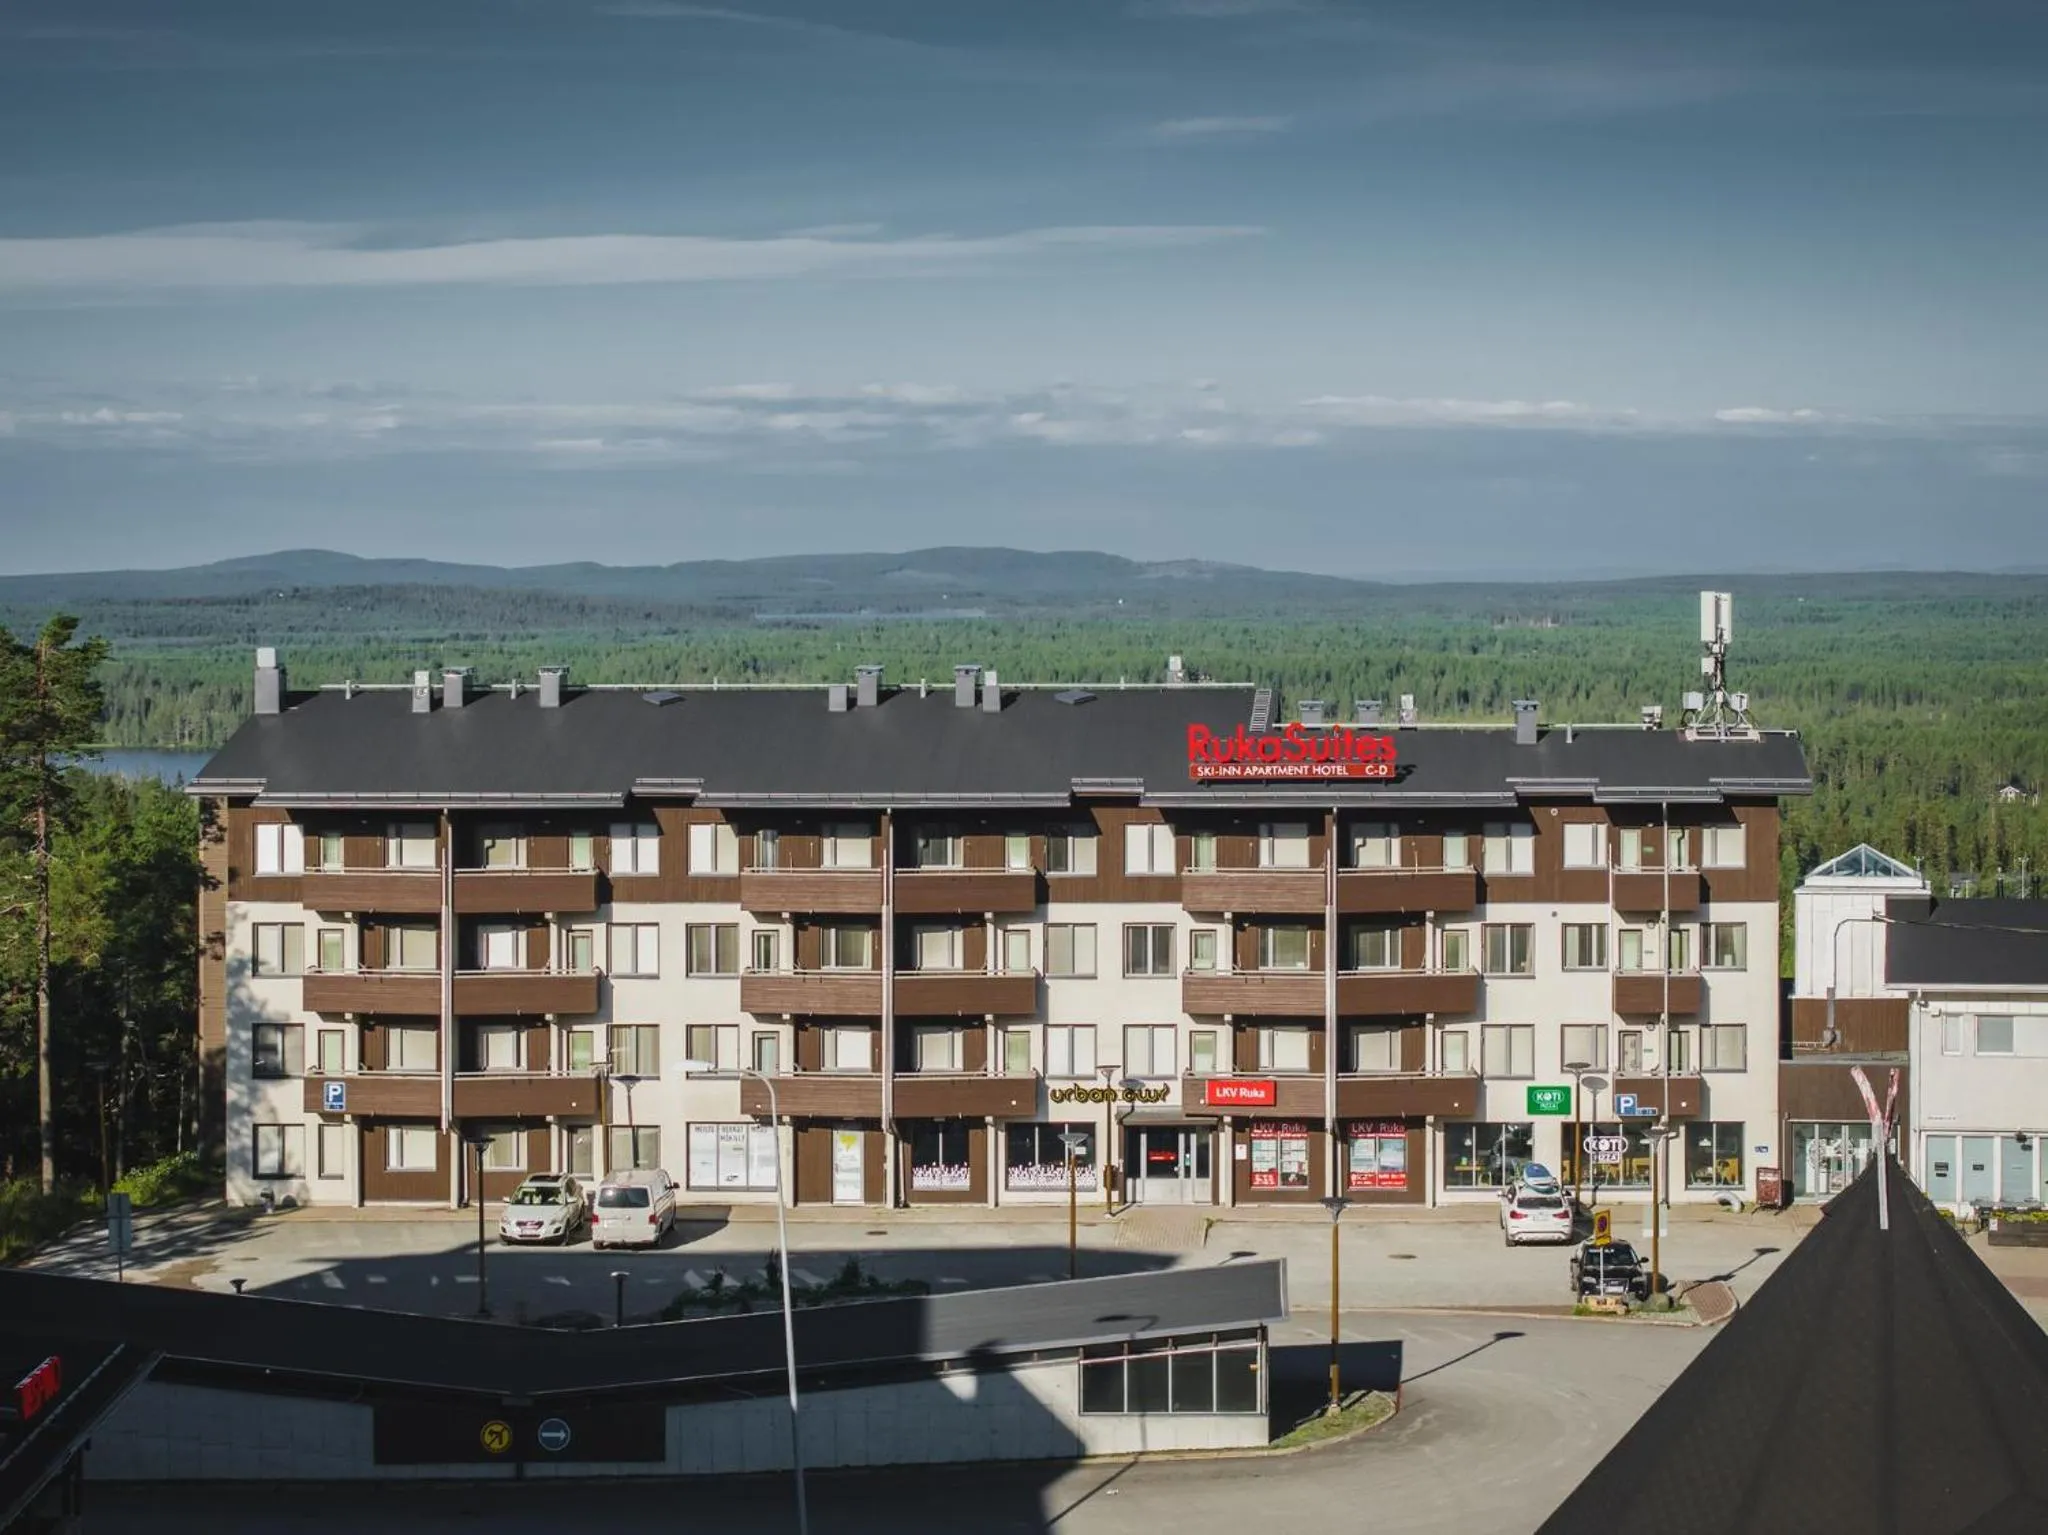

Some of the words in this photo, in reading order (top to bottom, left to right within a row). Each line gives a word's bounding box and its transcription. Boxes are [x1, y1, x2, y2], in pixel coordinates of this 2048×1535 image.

[1187, 722, 1397, 763] RukaSuites
[1244, 765, 1308, 776] APARTMENT
[1312, 765, 1349, 775] HOTEL
[1365, 765, 1387, 776] C-D
[329, 1085, 342, 1102] P
[1050, 1083, 1118, 1103] urban
[1216, 1087, 1238, 1098] LKV
[1240, 1087, 1265, 1098] Ruka
[1536, 1091, 1561, 1102] KOTI
[1620, 1096, 1633, 1113] P
[1253, 1123, 1275, 1132] LKV
[1281, 1123, 1307, 1133] Ruka
[1352, 1123, 1373, 1133] LKV
[1380, 1123, 1405, 1133] Ruka
